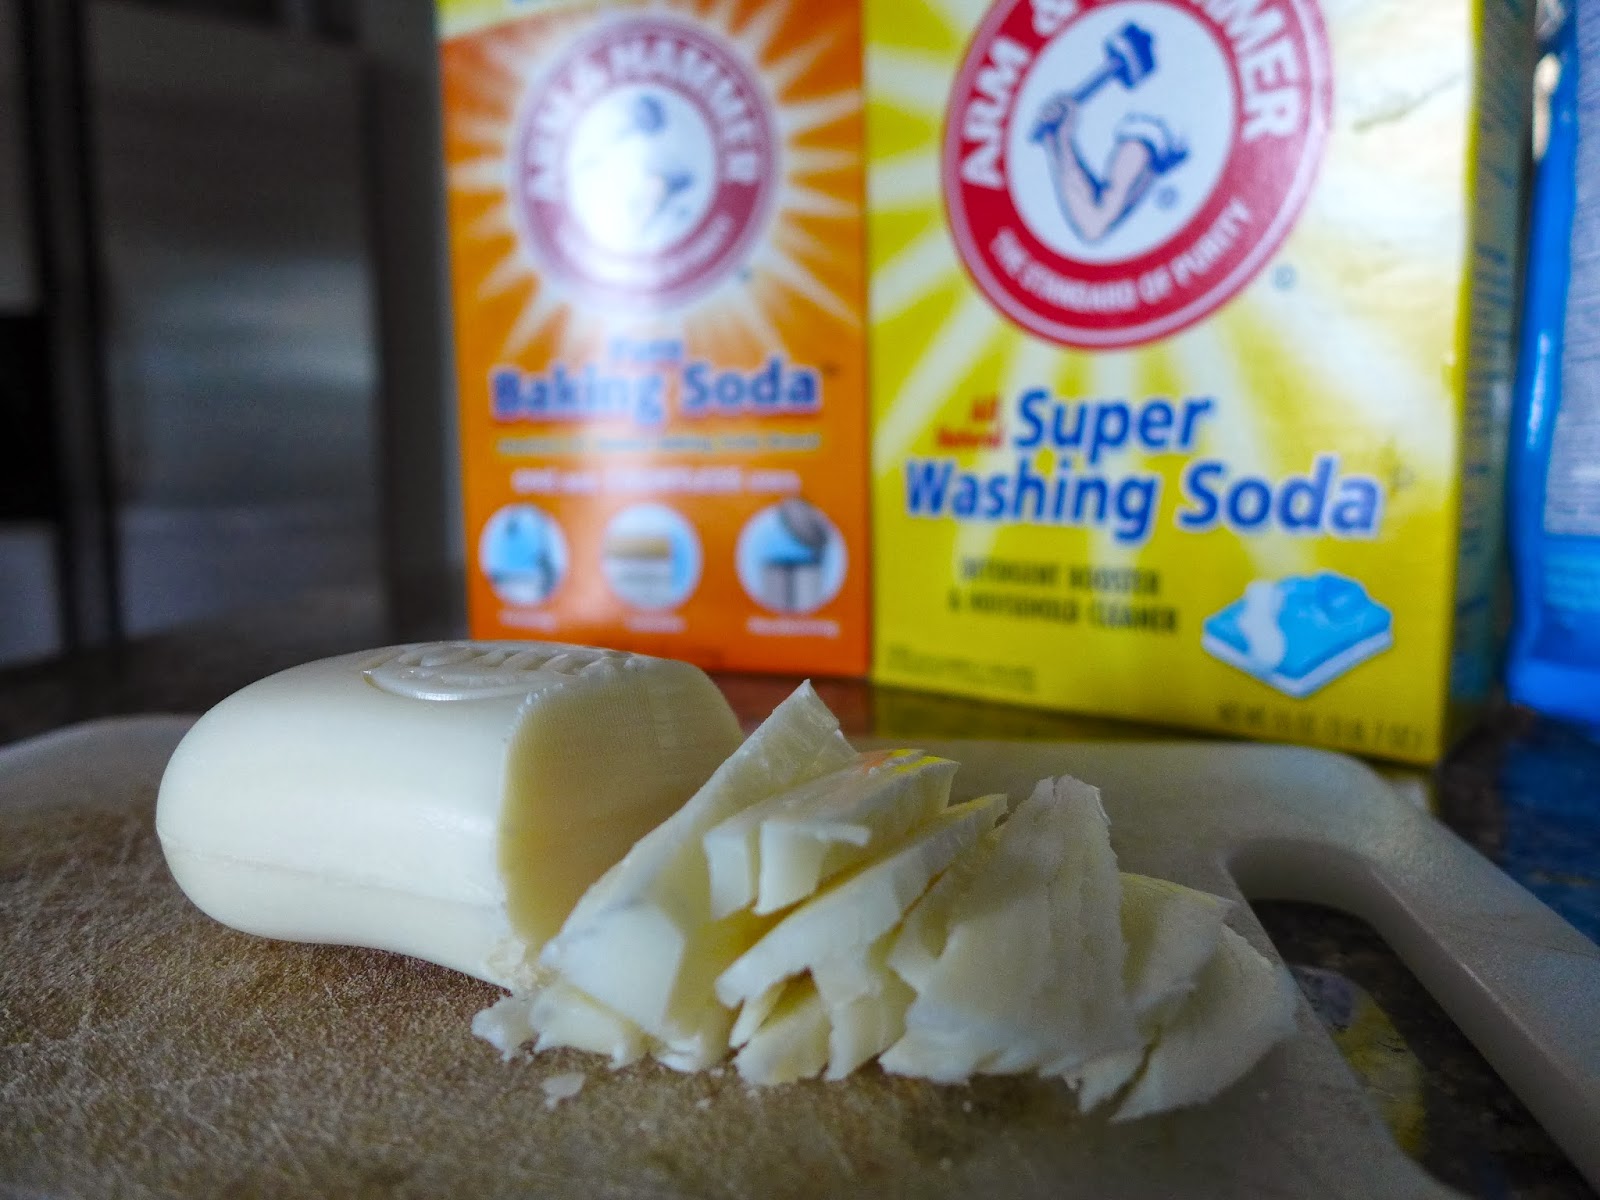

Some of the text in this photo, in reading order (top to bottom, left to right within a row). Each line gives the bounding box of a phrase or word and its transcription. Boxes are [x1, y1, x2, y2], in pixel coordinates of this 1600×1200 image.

[962, 37, 1030, 189] ARM
[1168, 198, 1251, 288] PURITY
[494, 356, 819, 425] Baking Soda
[1013, 387, 1216, 464] Super
[904, 455, 1384, 545] Washing Soda
